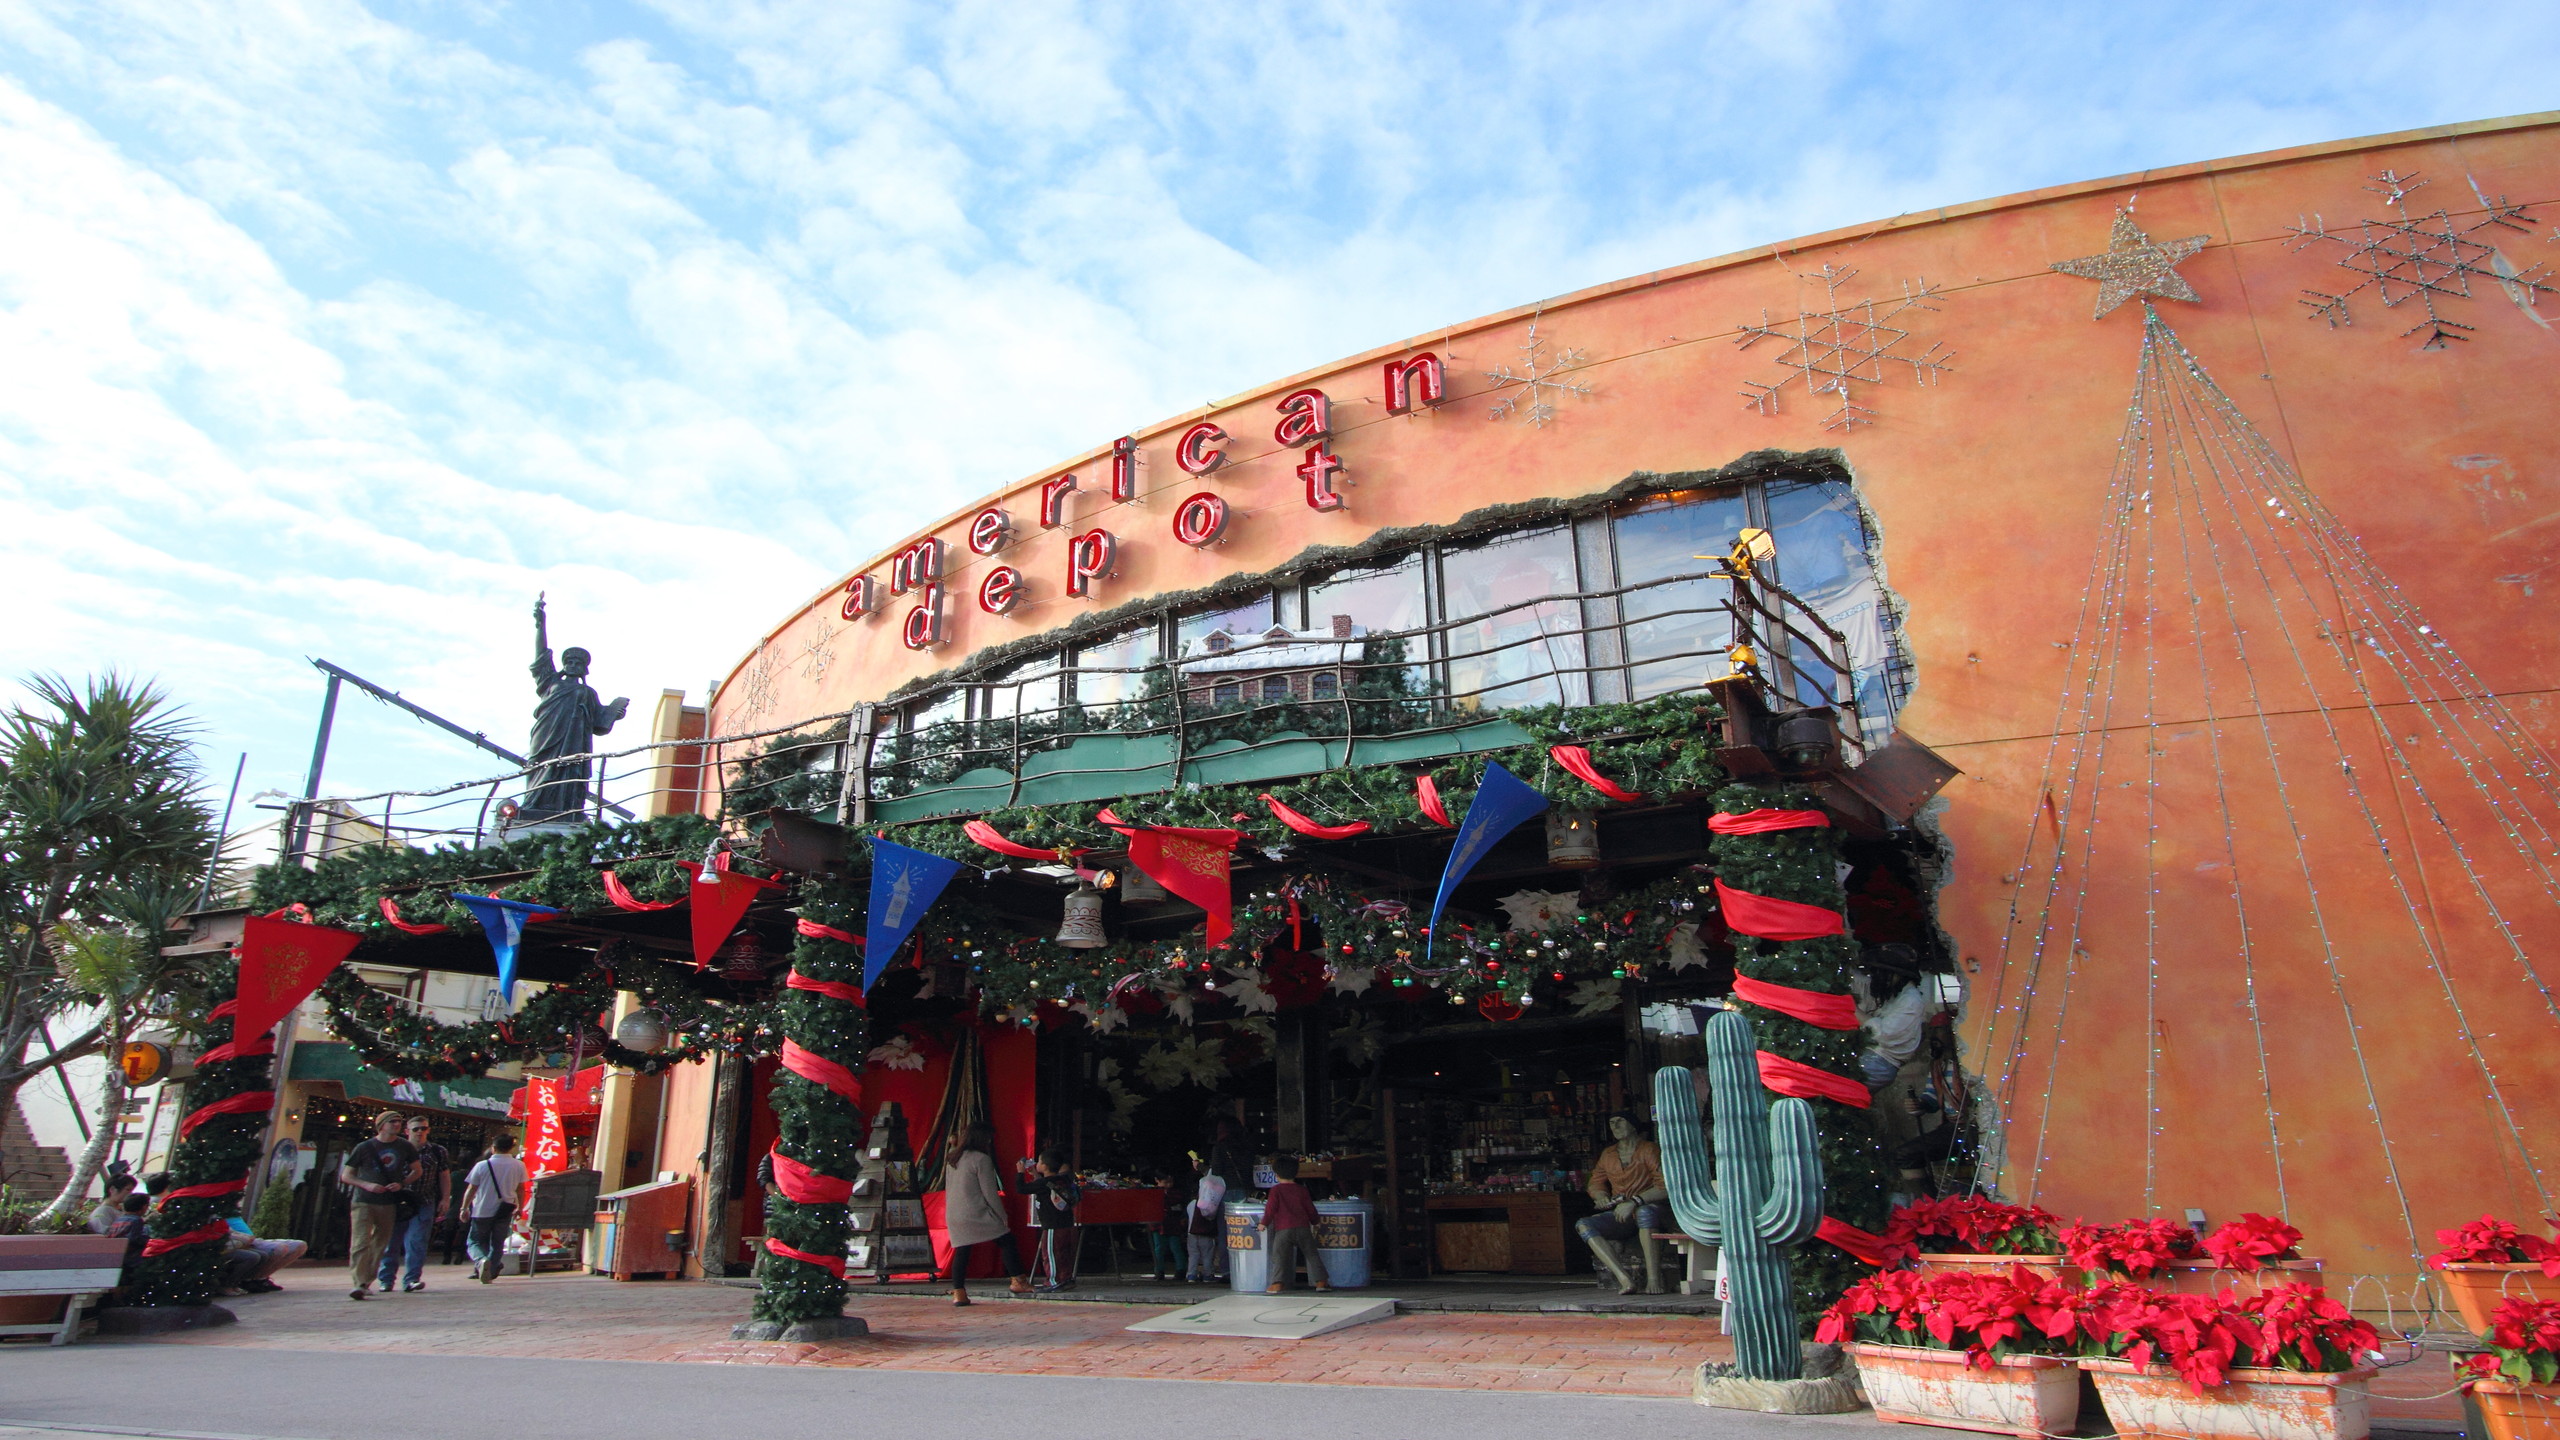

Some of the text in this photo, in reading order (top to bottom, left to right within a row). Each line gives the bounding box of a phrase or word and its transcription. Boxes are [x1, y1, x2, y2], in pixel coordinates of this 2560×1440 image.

[841, 351, 1446, 622] american
[904, 441, 1343, 651] depot
[1483, 992, 1514, 1008] STO
[1226, 1217, 1250, 1226] USED
[1321, 1216, 1355, 1225] USED
[1319, 1234, 1358, 1247] ¥280
